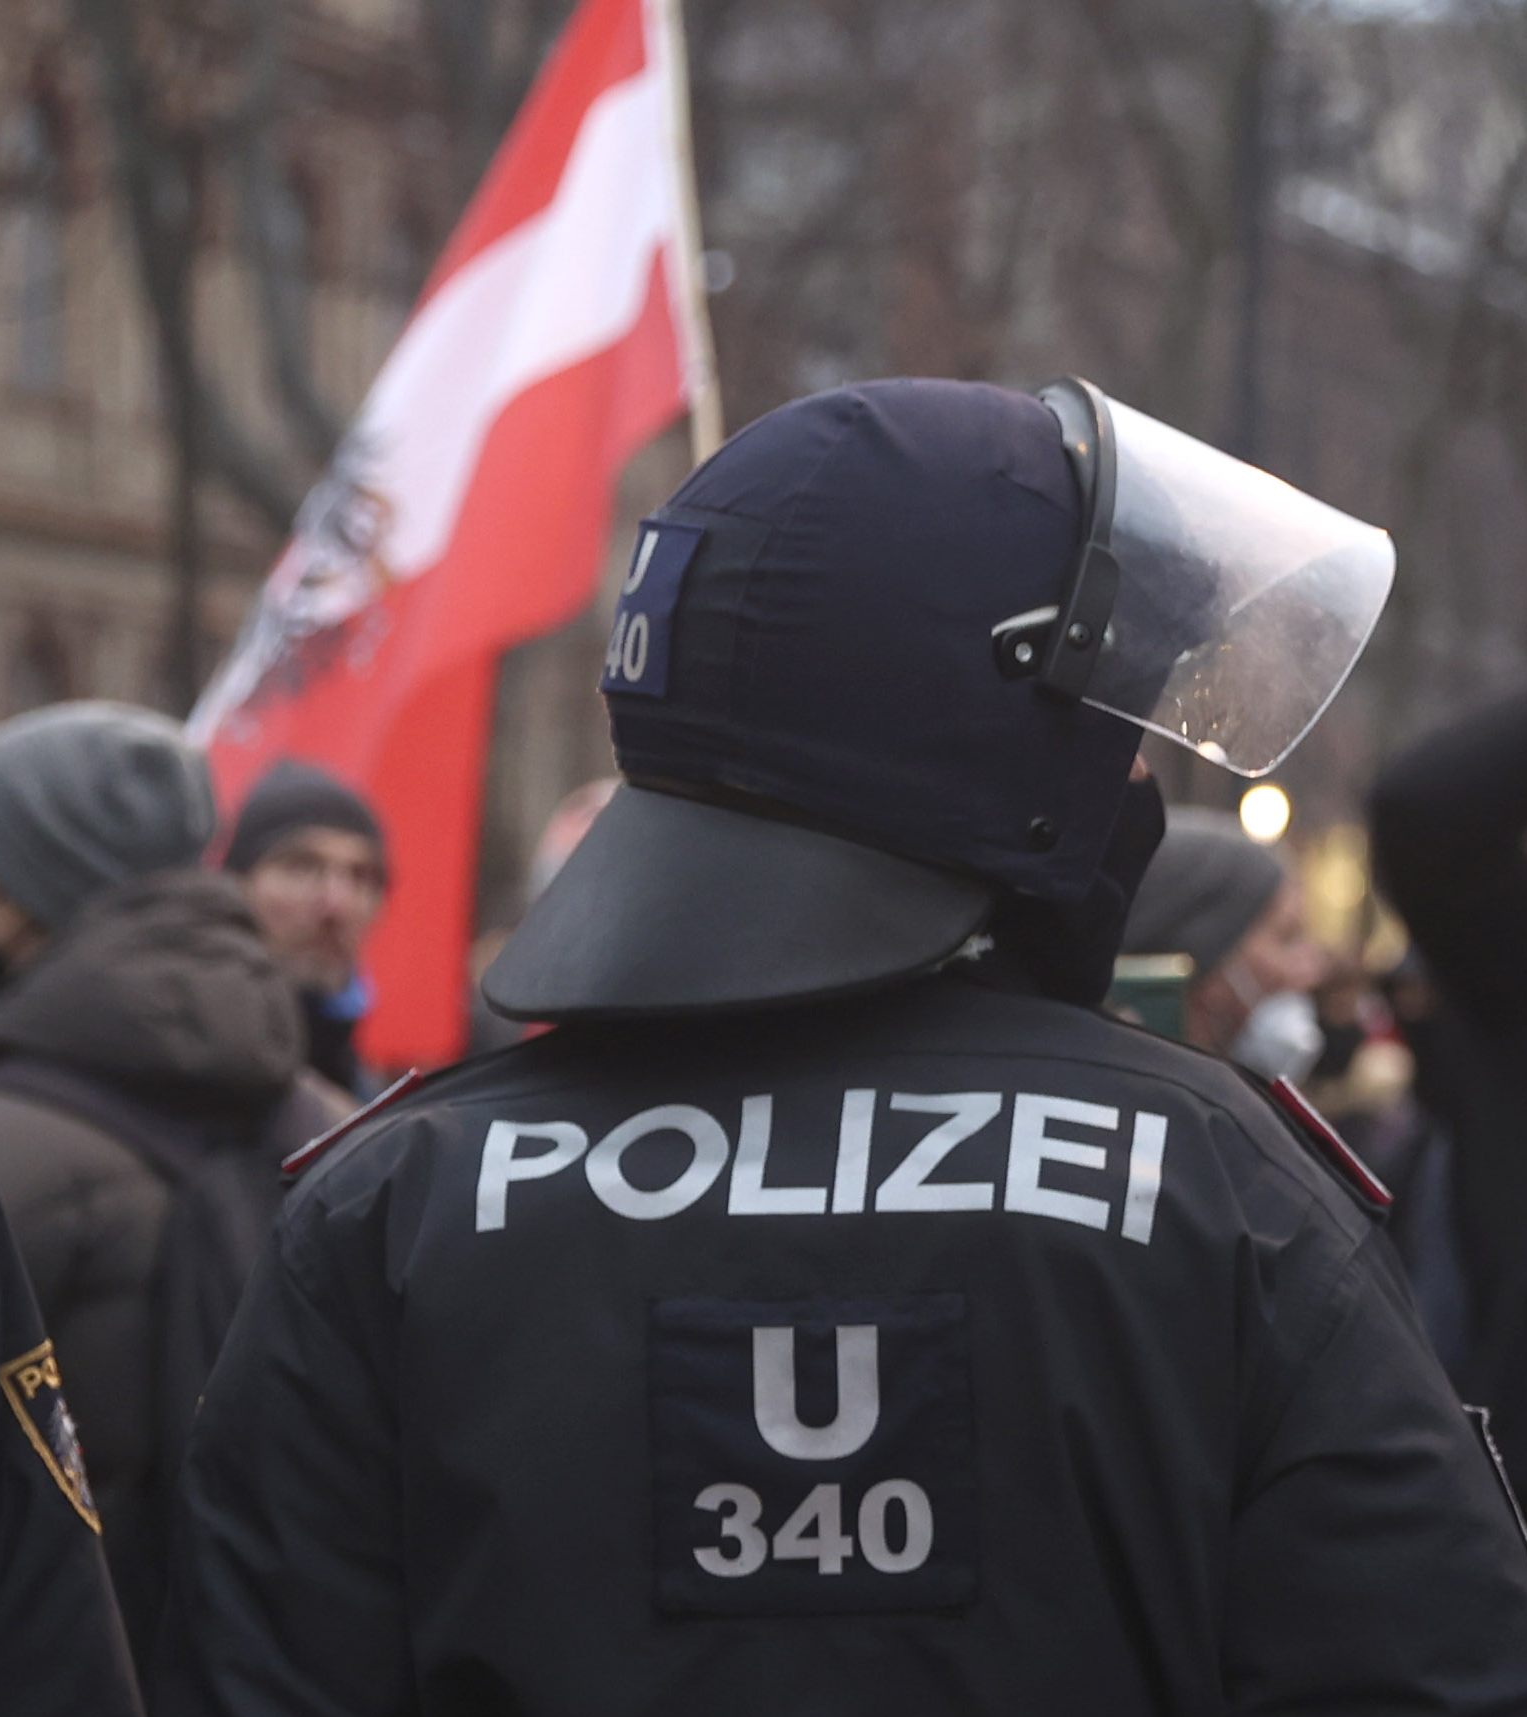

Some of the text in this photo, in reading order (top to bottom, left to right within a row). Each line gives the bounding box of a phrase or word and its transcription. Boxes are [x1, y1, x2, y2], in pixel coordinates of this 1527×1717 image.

[475, 1088, 1168, 1246] POLIZEI
[752, 1324, 881, 1462] U
[692, 1478, 935, 1578] 340
